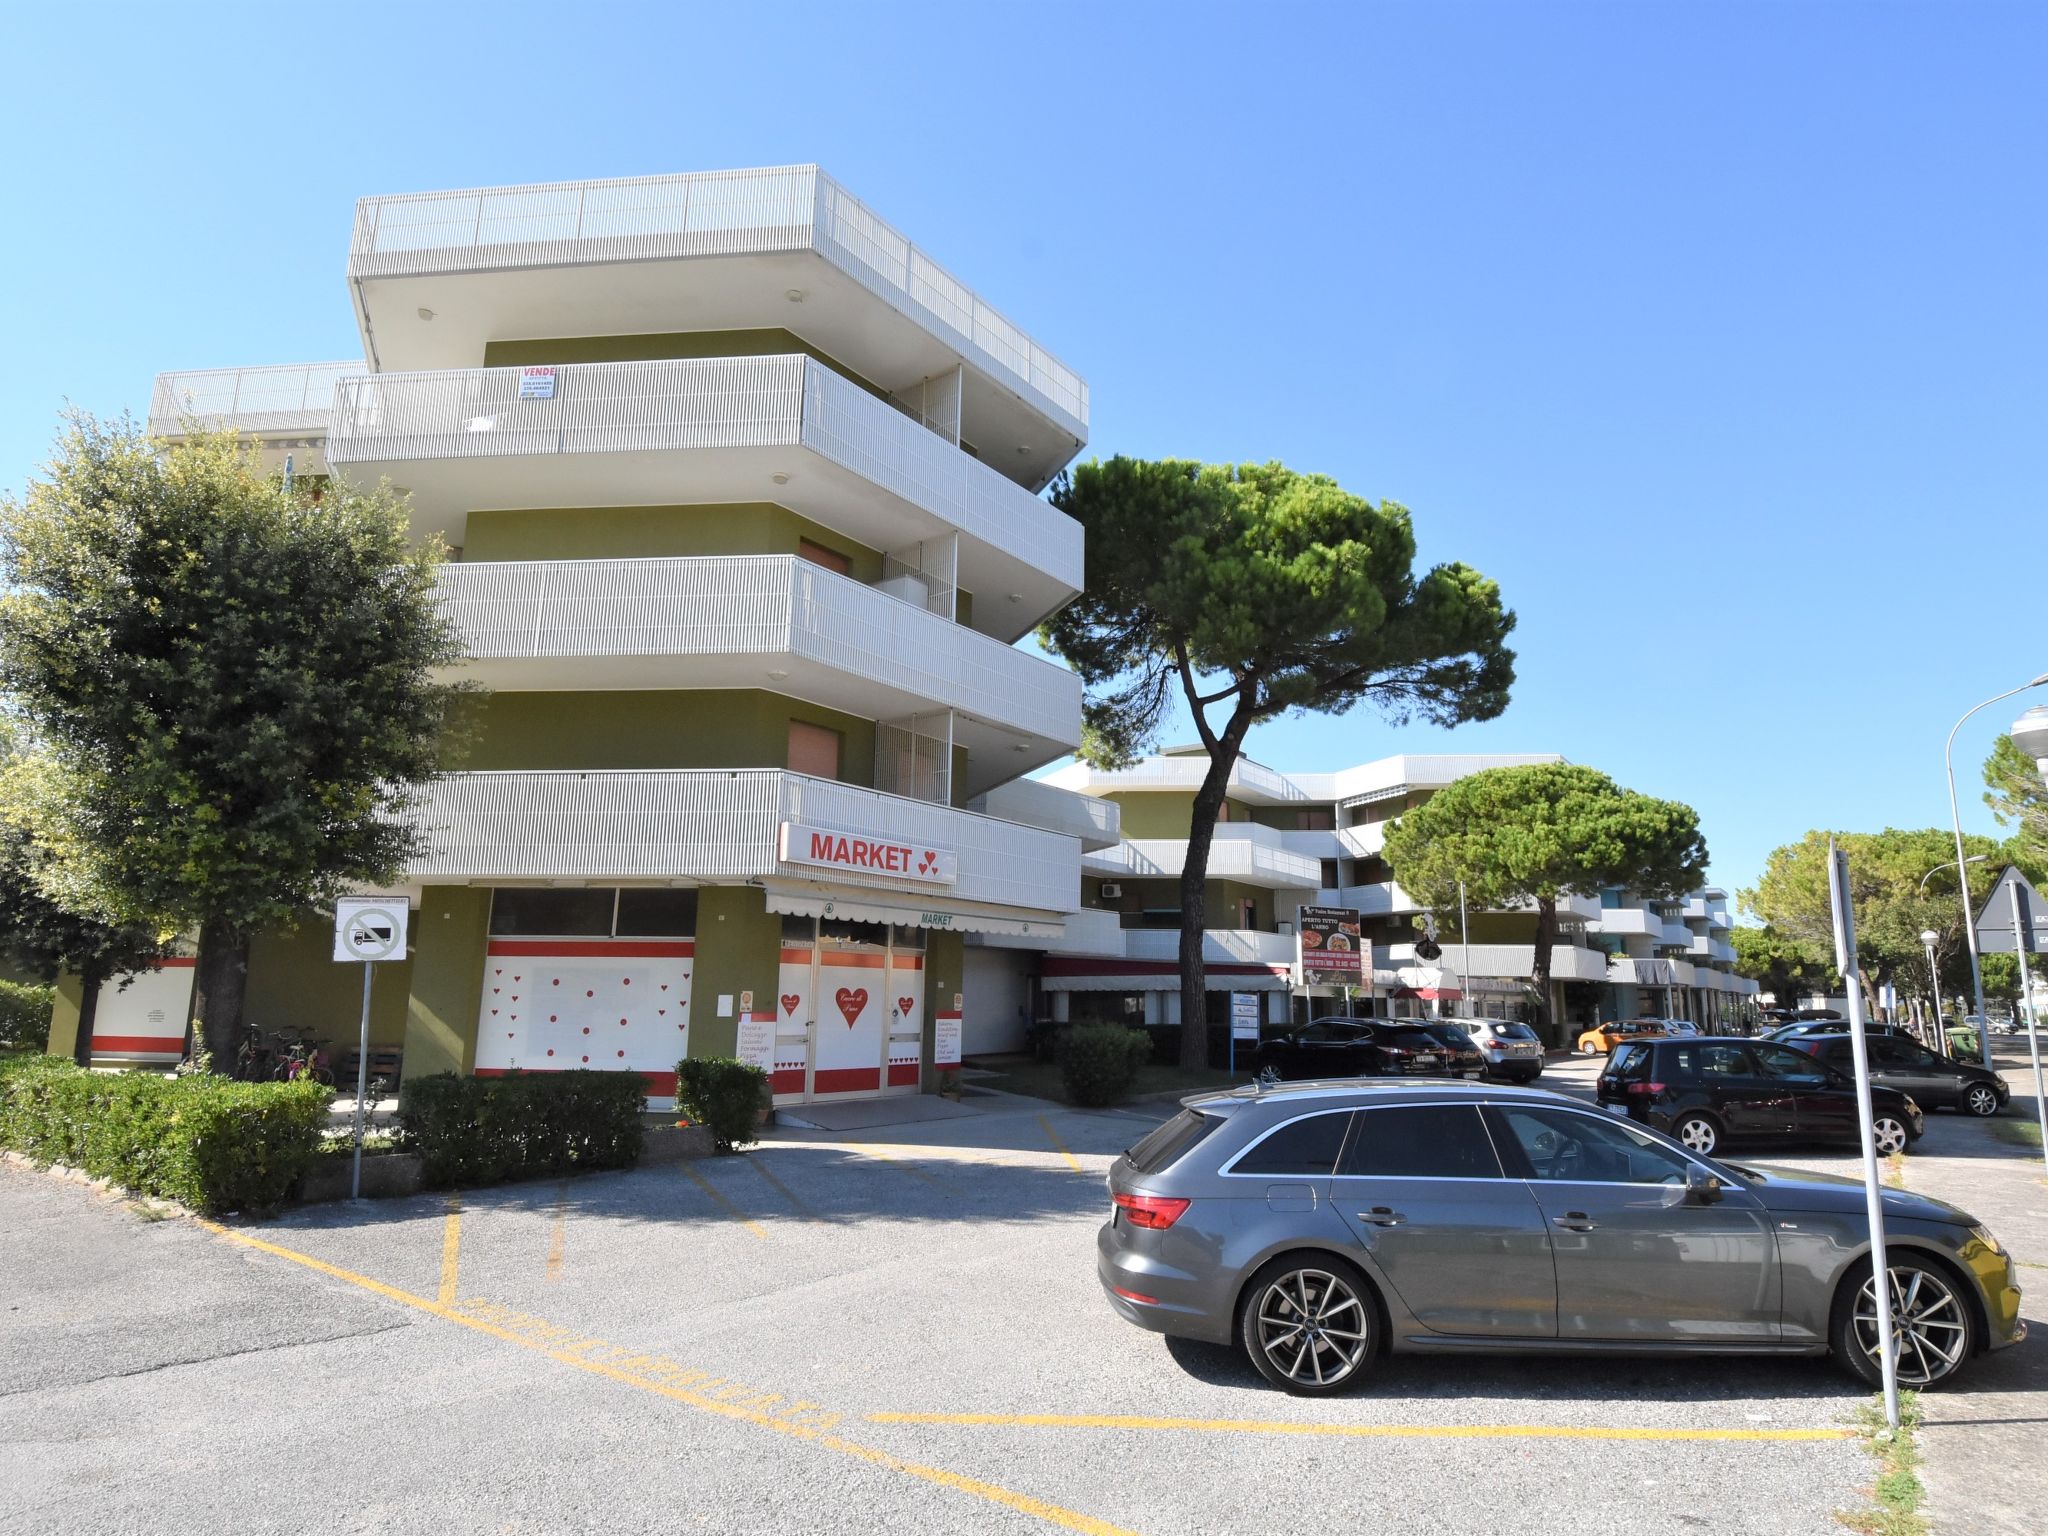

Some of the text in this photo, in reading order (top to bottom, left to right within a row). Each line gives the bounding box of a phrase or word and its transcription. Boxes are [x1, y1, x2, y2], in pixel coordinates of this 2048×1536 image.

[524, 367, 556, 377] VENDE
[810, 833, 912, 873] MARKET
[920, 913, 953, 926] MARKET
